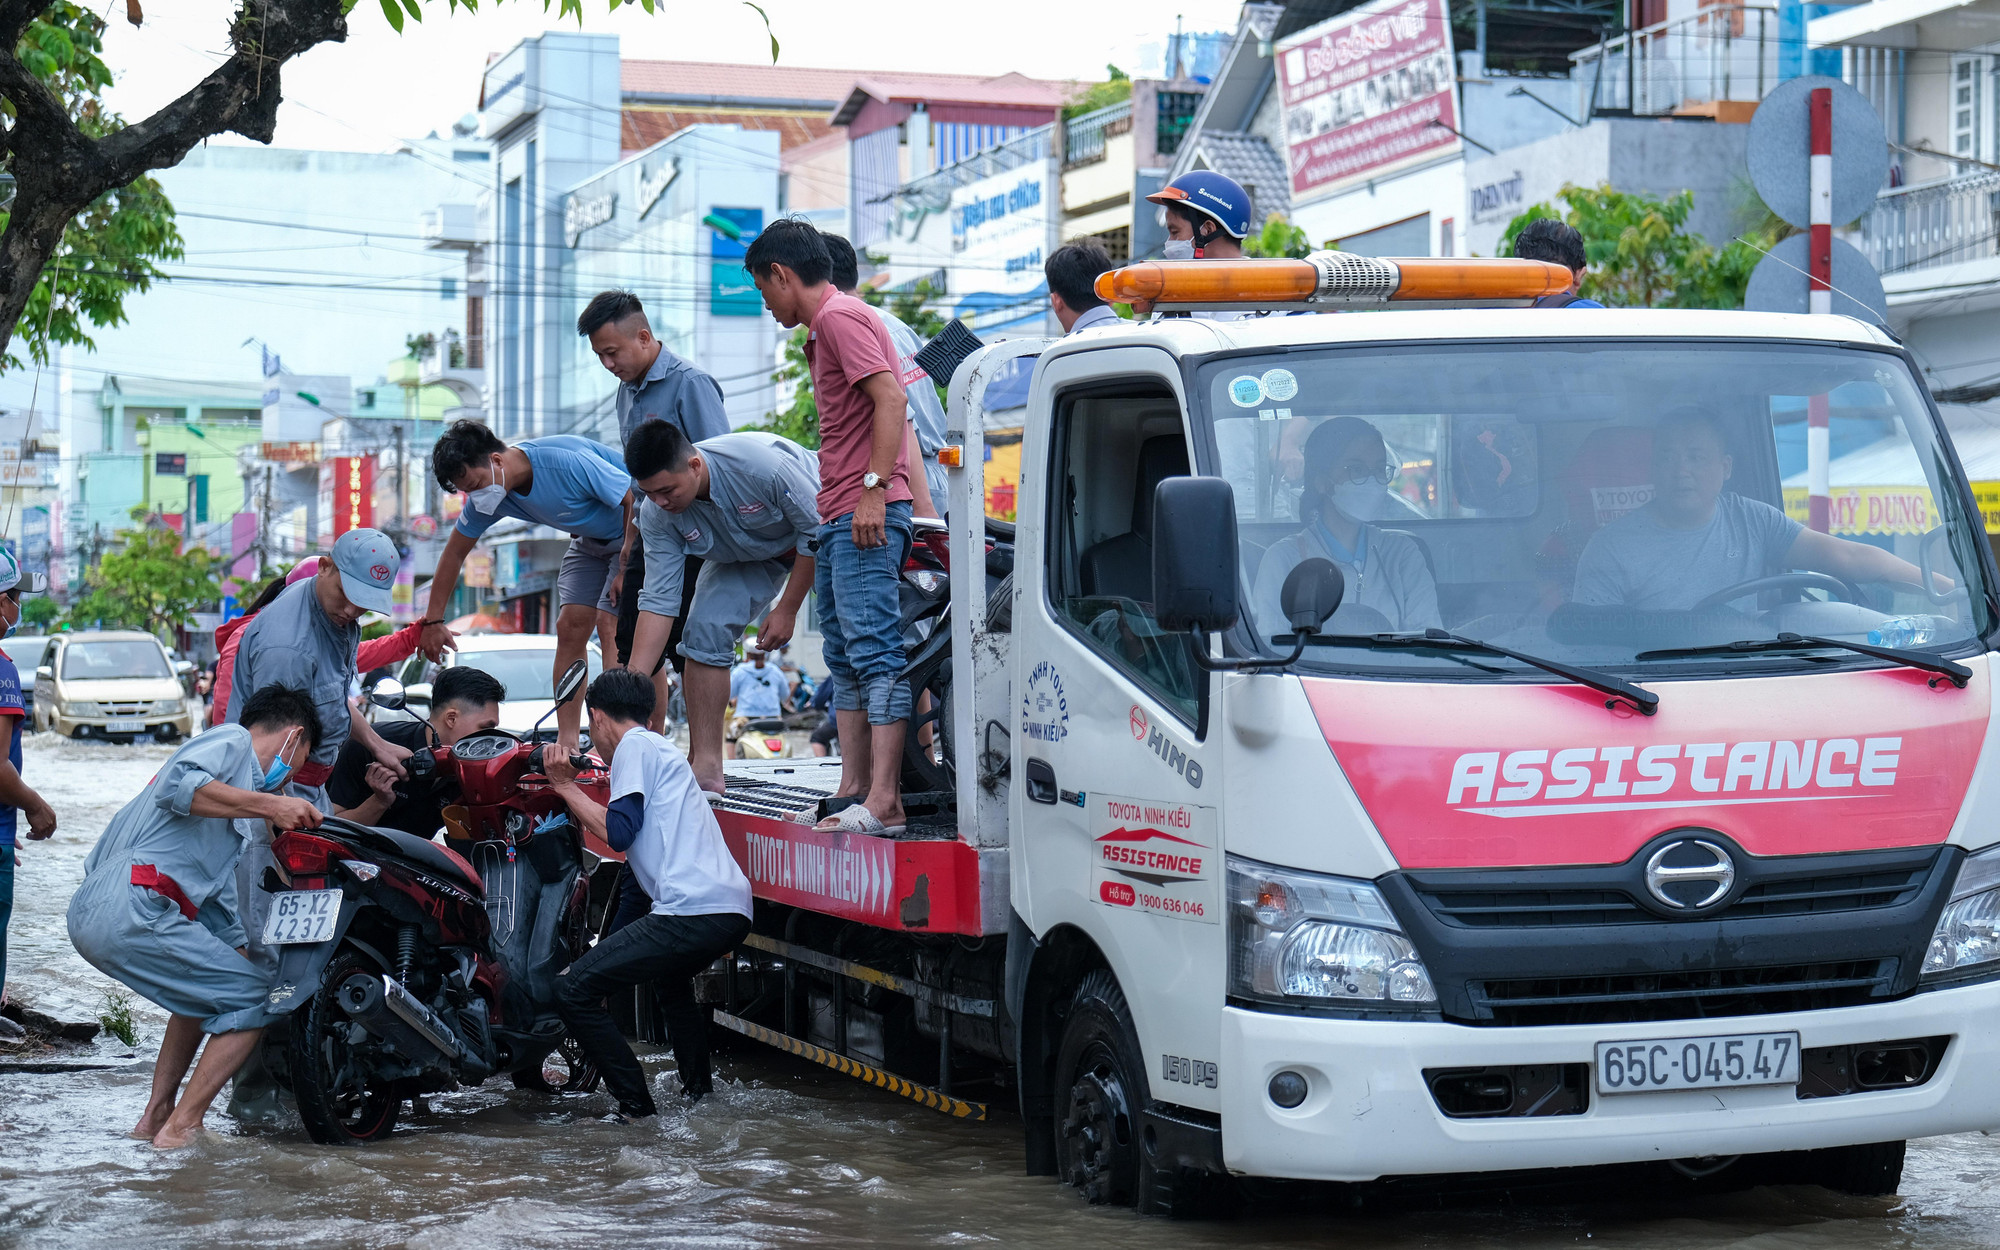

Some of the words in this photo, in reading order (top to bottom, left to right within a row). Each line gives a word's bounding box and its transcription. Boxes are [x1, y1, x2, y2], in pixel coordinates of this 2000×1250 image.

[1197, 187, 1234, 211] Sacombank
[1608, 488, 1656, 505] TOYOT
[1867, 496, 1928, 529] DUNG
[1028, 661, 1048, 690] TNHH
[1049, 665, 1070, 738] TOYOTA
[1028, 721, 1043, 739] NINH
[1147, 729, 1204, 789] HINO
[1446, 736, 1903, 805] ASSISTANCE
[1107, 801, 1142, 823] TOYOTA
[1144, 806, 1166, 826] NINH
[745, 831, 792, 889] TOYOTA
[795, 841, 826, 897] NINH
[829, 833, 861, 905] KIỀU
[1102, 844, 1203, 875] ASSISTANCE
[277, 893, 331, 917] 65-X2
[1109, 886, 1120, 899] Hỗ
[1139, 893, 1161, 910] 1900
[1162, 897, 1182, 913] 636
[1183, 902, 1205, 918] 046
[274, 916, 327, 941] 4237
[1604, 1037, 1792, 1088] 65C-045.47
